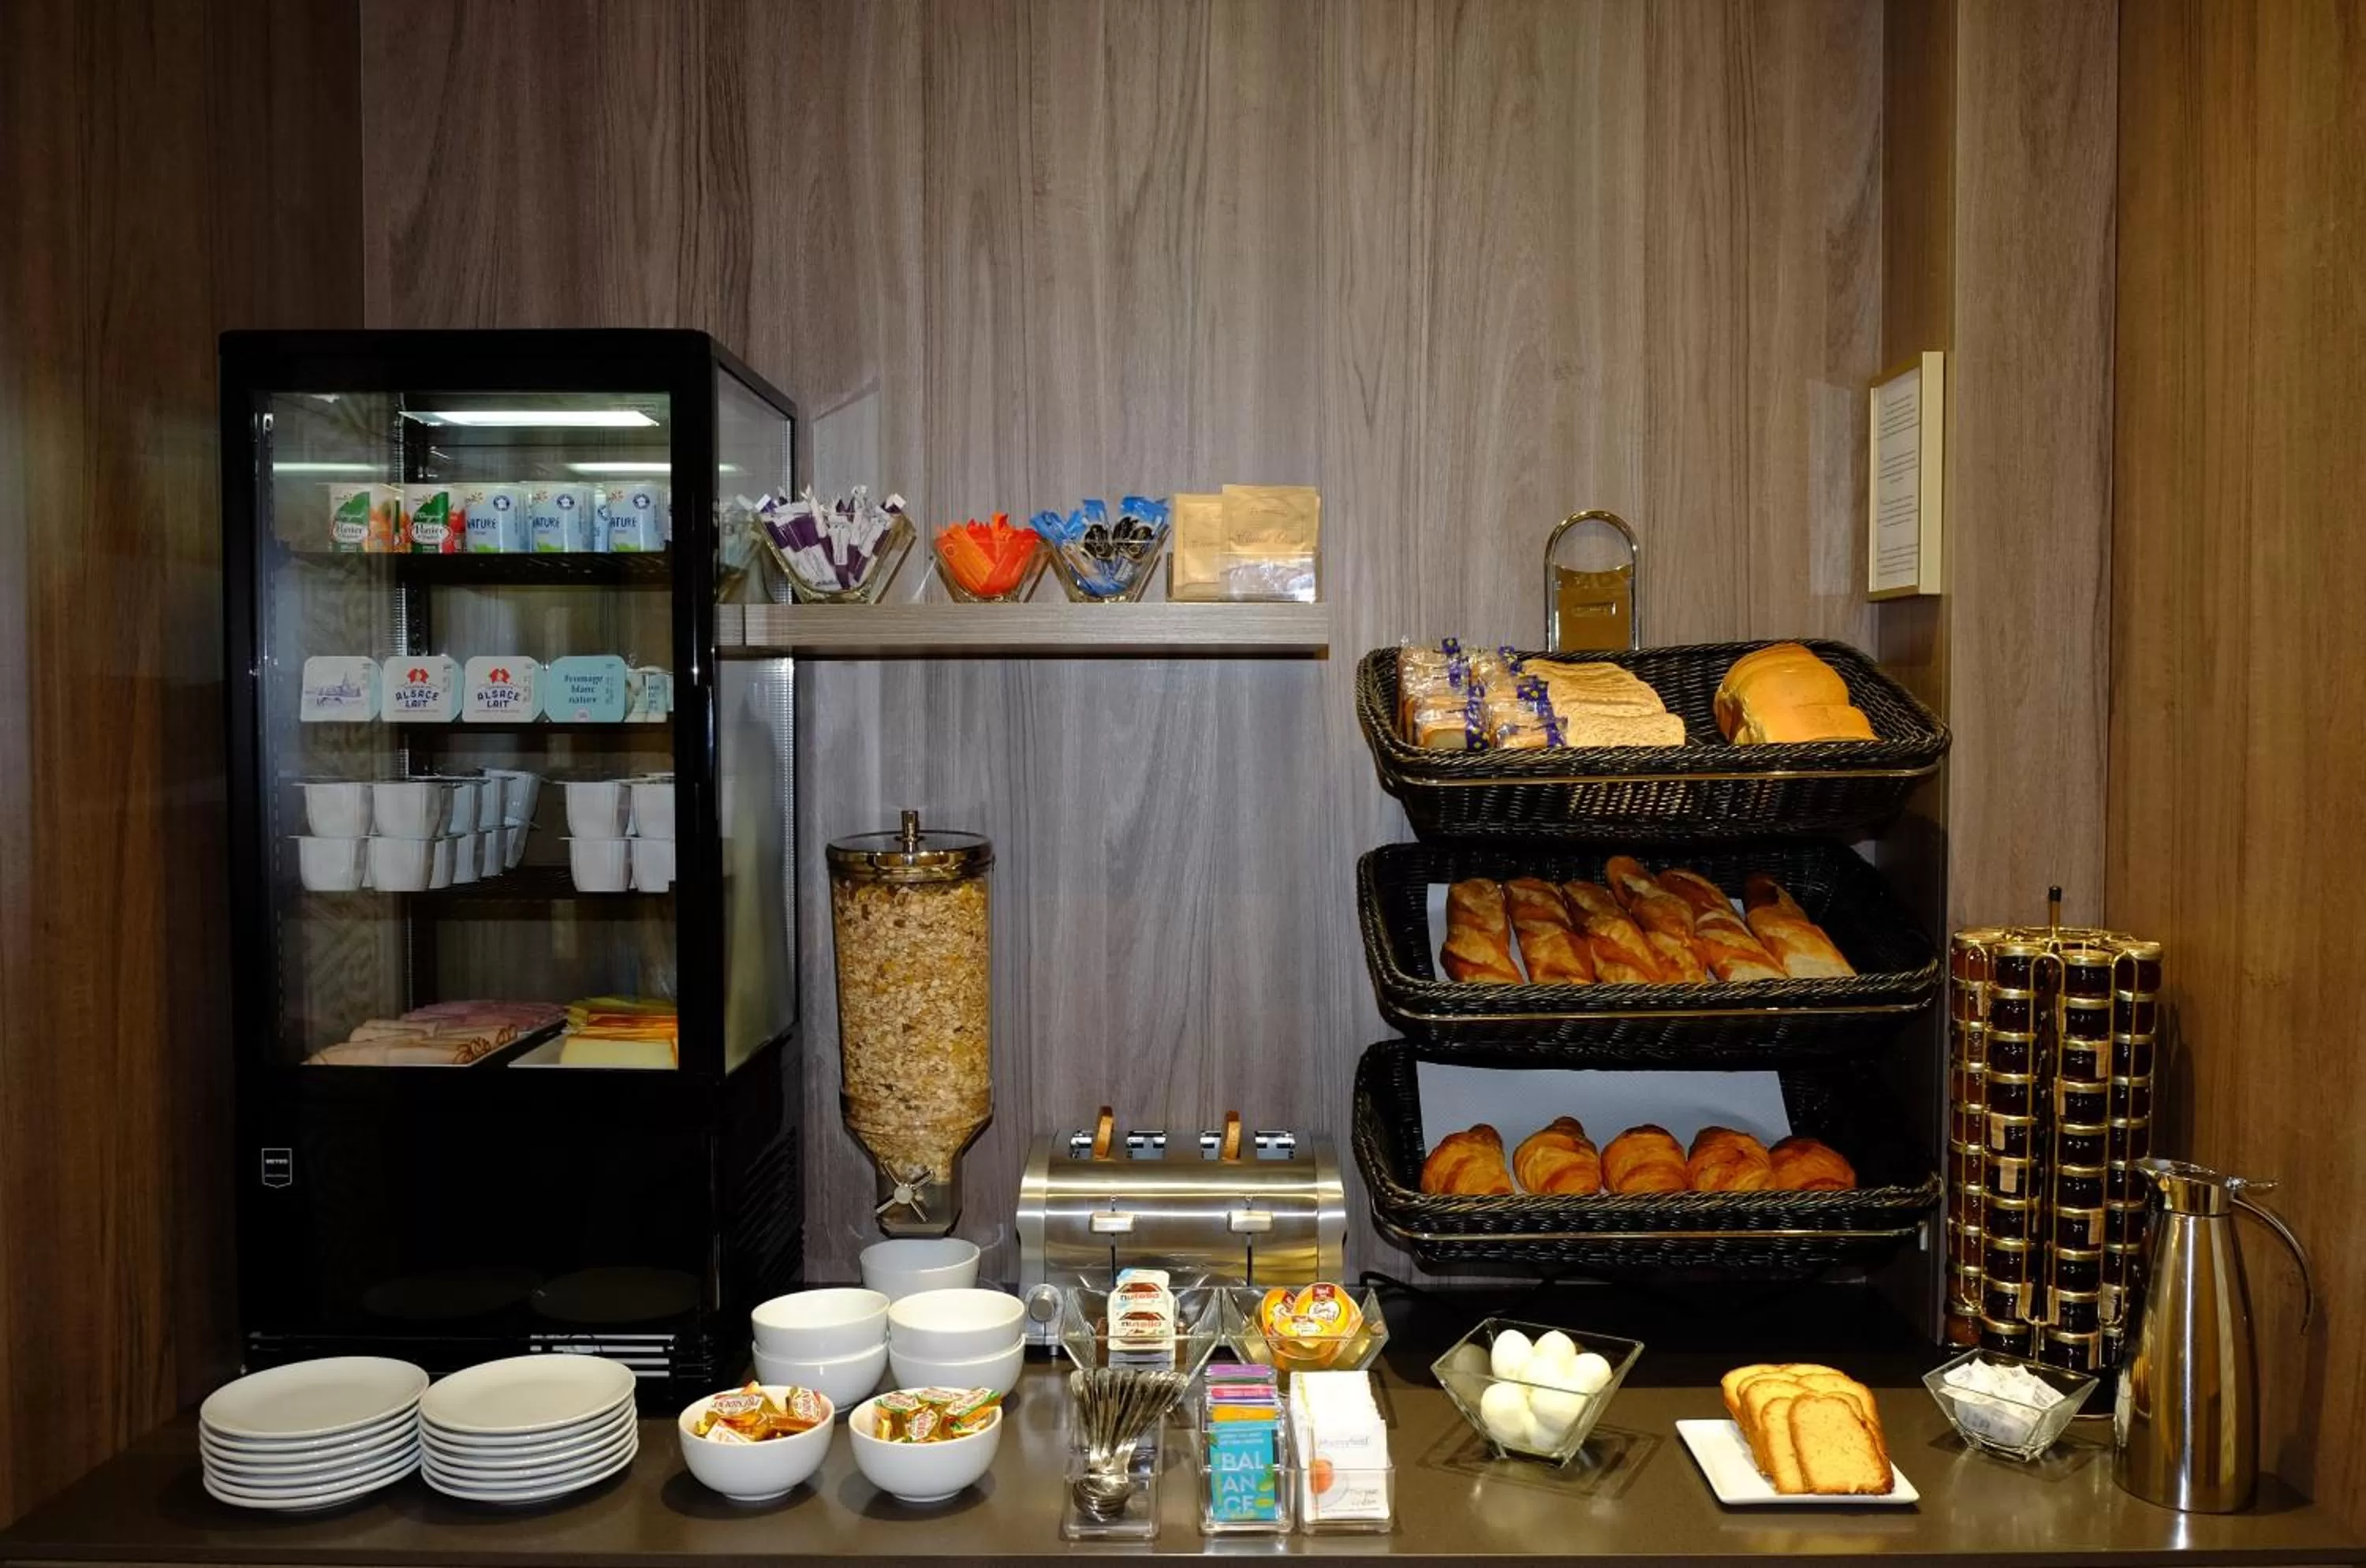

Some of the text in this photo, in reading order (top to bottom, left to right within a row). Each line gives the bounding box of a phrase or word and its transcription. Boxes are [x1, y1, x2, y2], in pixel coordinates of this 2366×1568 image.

[395, 689, 439, 701] ALSACE
[477, 689, 521, 701] ALSACE
[405, 699, 428, 708] LAIT
[487, 699, 509, 708] LAIT
[1121, 1320, 1161, 1328] nutella
[1222, 1450, 1264, 1471] BAL
[1222, 1475, 1256, 1493] AN
